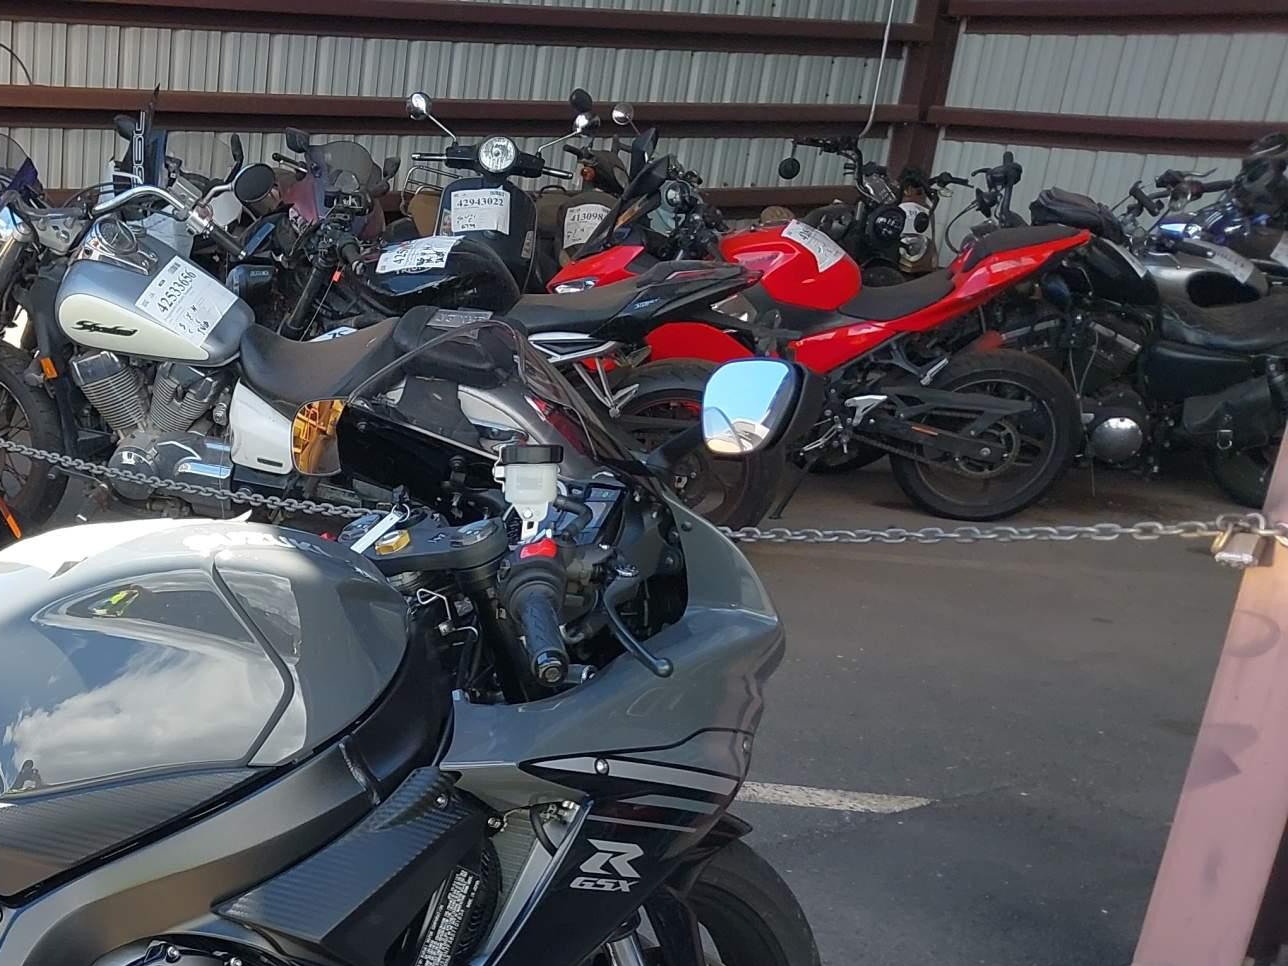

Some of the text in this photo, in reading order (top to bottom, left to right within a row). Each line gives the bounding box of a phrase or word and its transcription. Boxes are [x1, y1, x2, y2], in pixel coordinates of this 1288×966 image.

[457, 197, 504, 207] 42943022
[156, 268, 197, 313] 42533656
[579, 838, 644, 878] R
[569, 876, 639, 893] GSX
